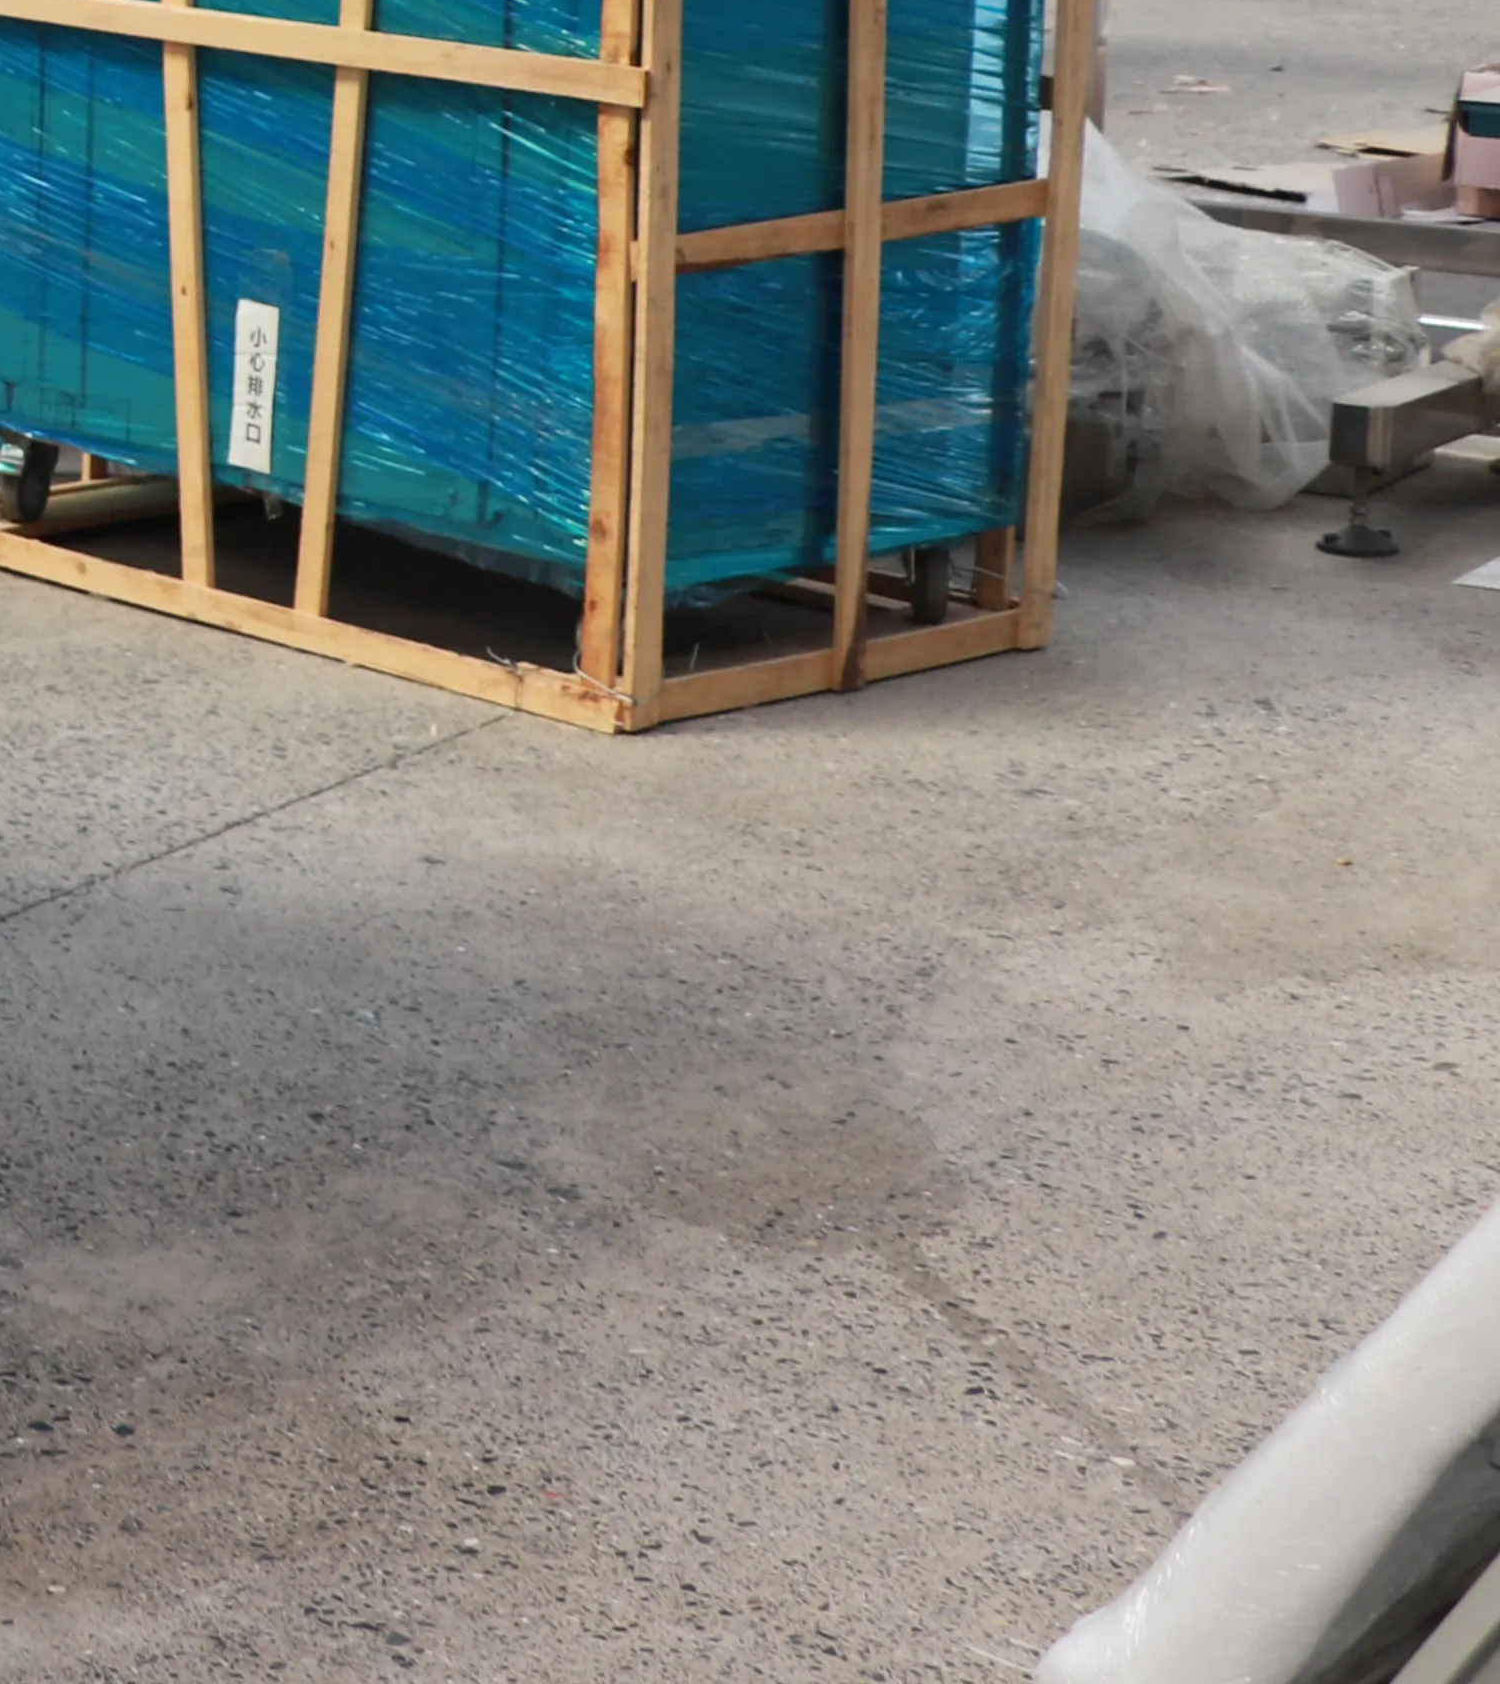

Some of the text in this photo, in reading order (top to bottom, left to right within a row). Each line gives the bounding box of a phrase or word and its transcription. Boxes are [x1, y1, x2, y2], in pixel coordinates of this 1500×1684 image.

[245, 327, 268, 446] 小心排水口
